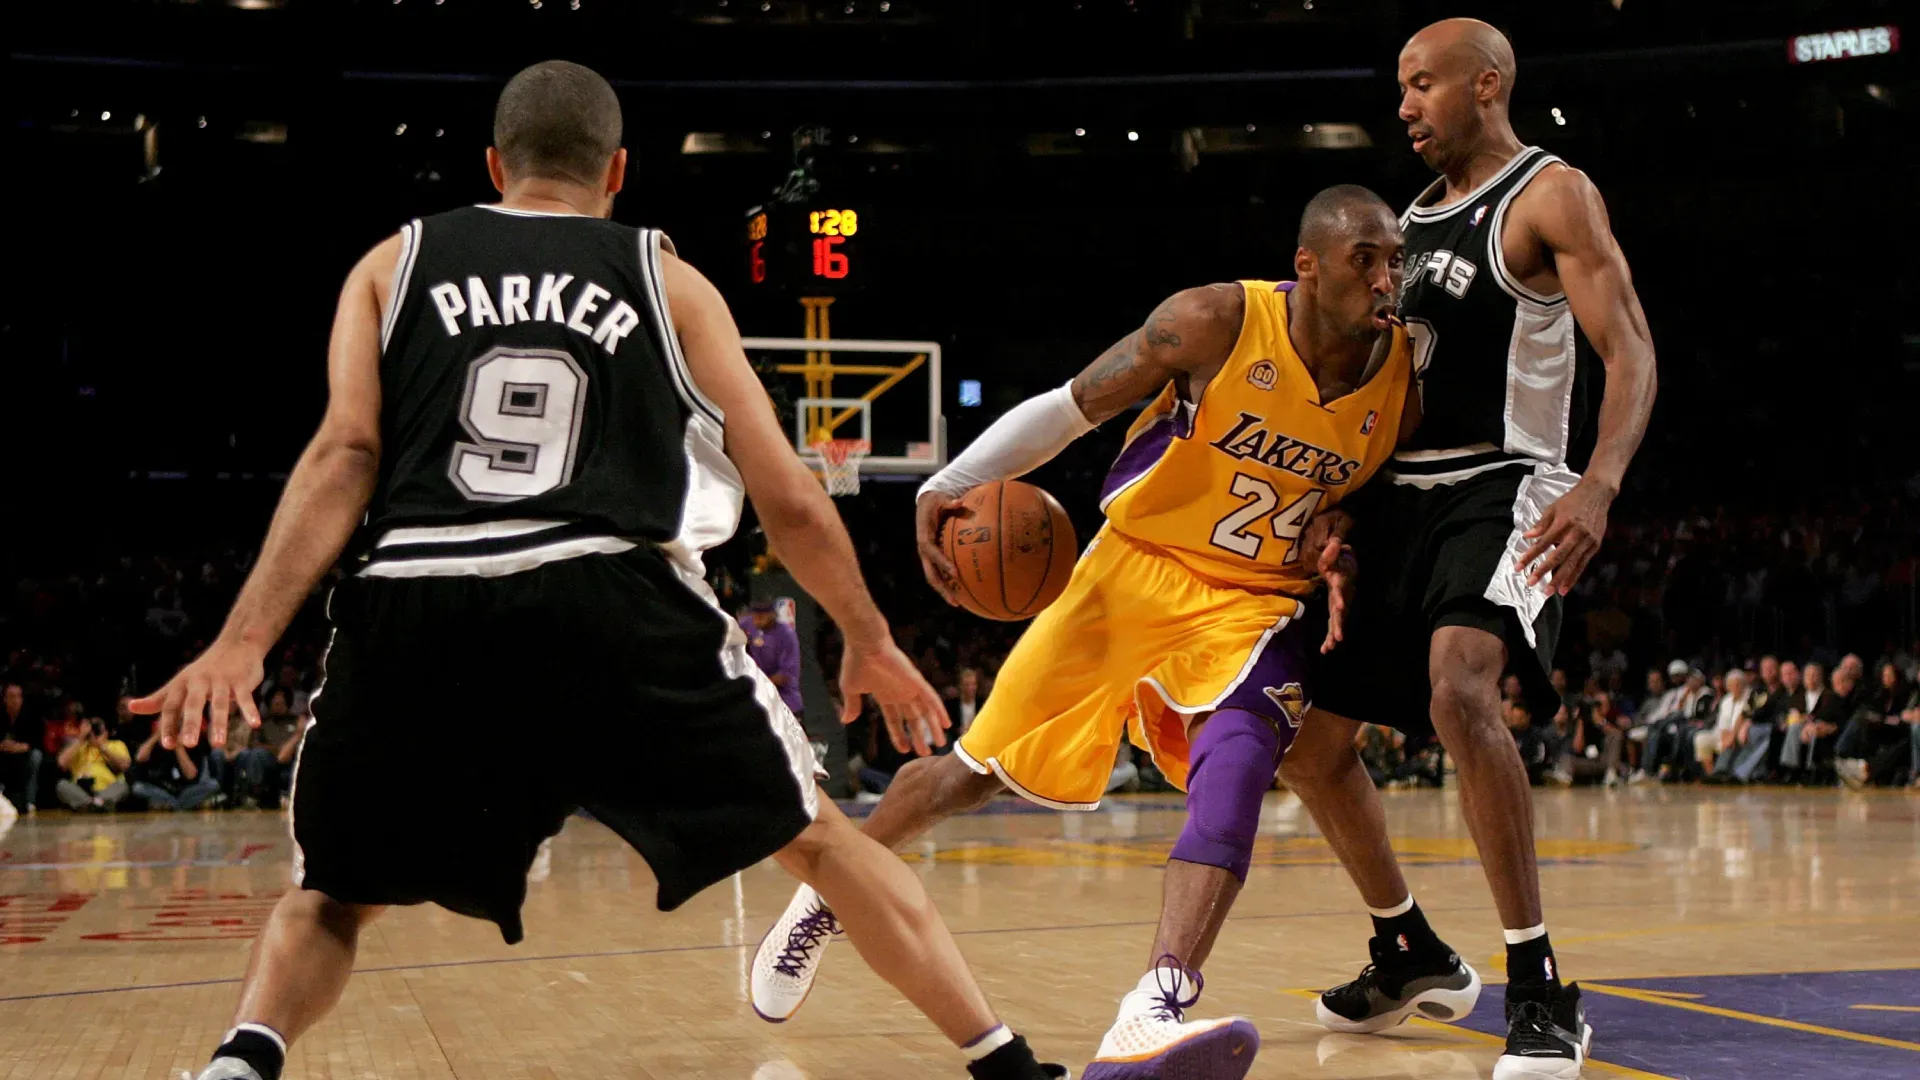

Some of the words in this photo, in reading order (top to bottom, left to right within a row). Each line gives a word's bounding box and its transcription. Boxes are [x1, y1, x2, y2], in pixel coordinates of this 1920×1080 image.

[1794, 26, 1891, 62] STAPLES
[813, 236, 849, 279] 16
[430, 272, 640, 355] PARKER
[1254, 366, 1274, 382] 60
[447, 346, 589, 503] 9
[1208, 411, 1362, 486] LAKERS
[1208, 471, 1326, 566] 24
